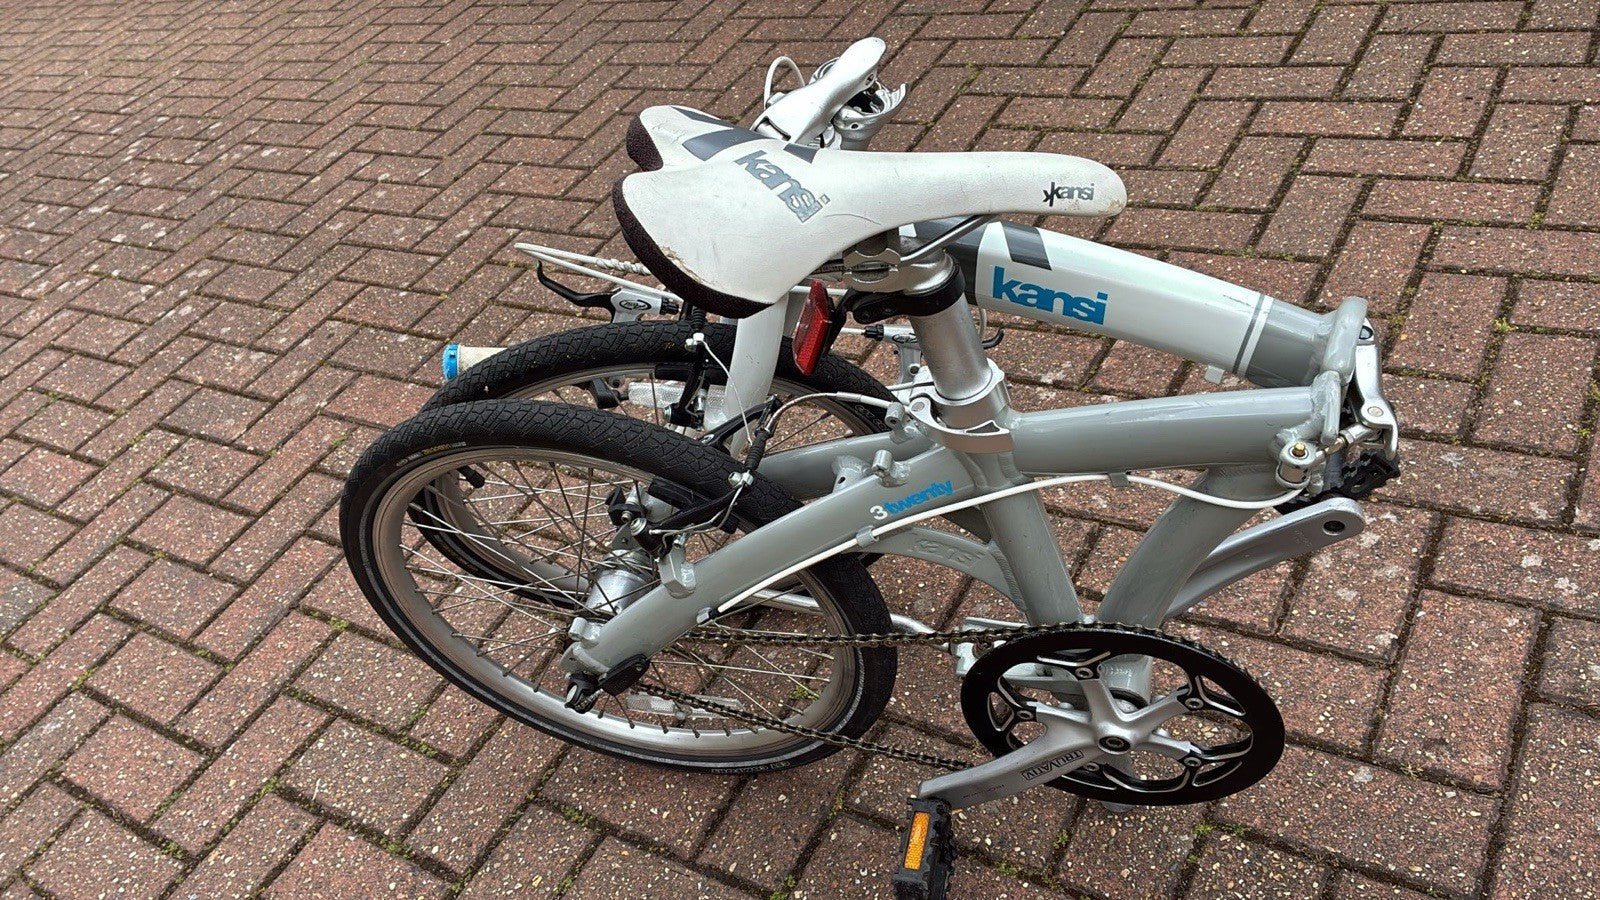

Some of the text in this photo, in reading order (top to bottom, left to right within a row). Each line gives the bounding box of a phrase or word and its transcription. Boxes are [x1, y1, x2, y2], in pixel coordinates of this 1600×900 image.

[733, 150, 830, 223] kansi
[993, 265, 1108, 325] kansi
[1022, 751, 1083, 780] TRUVATIV
